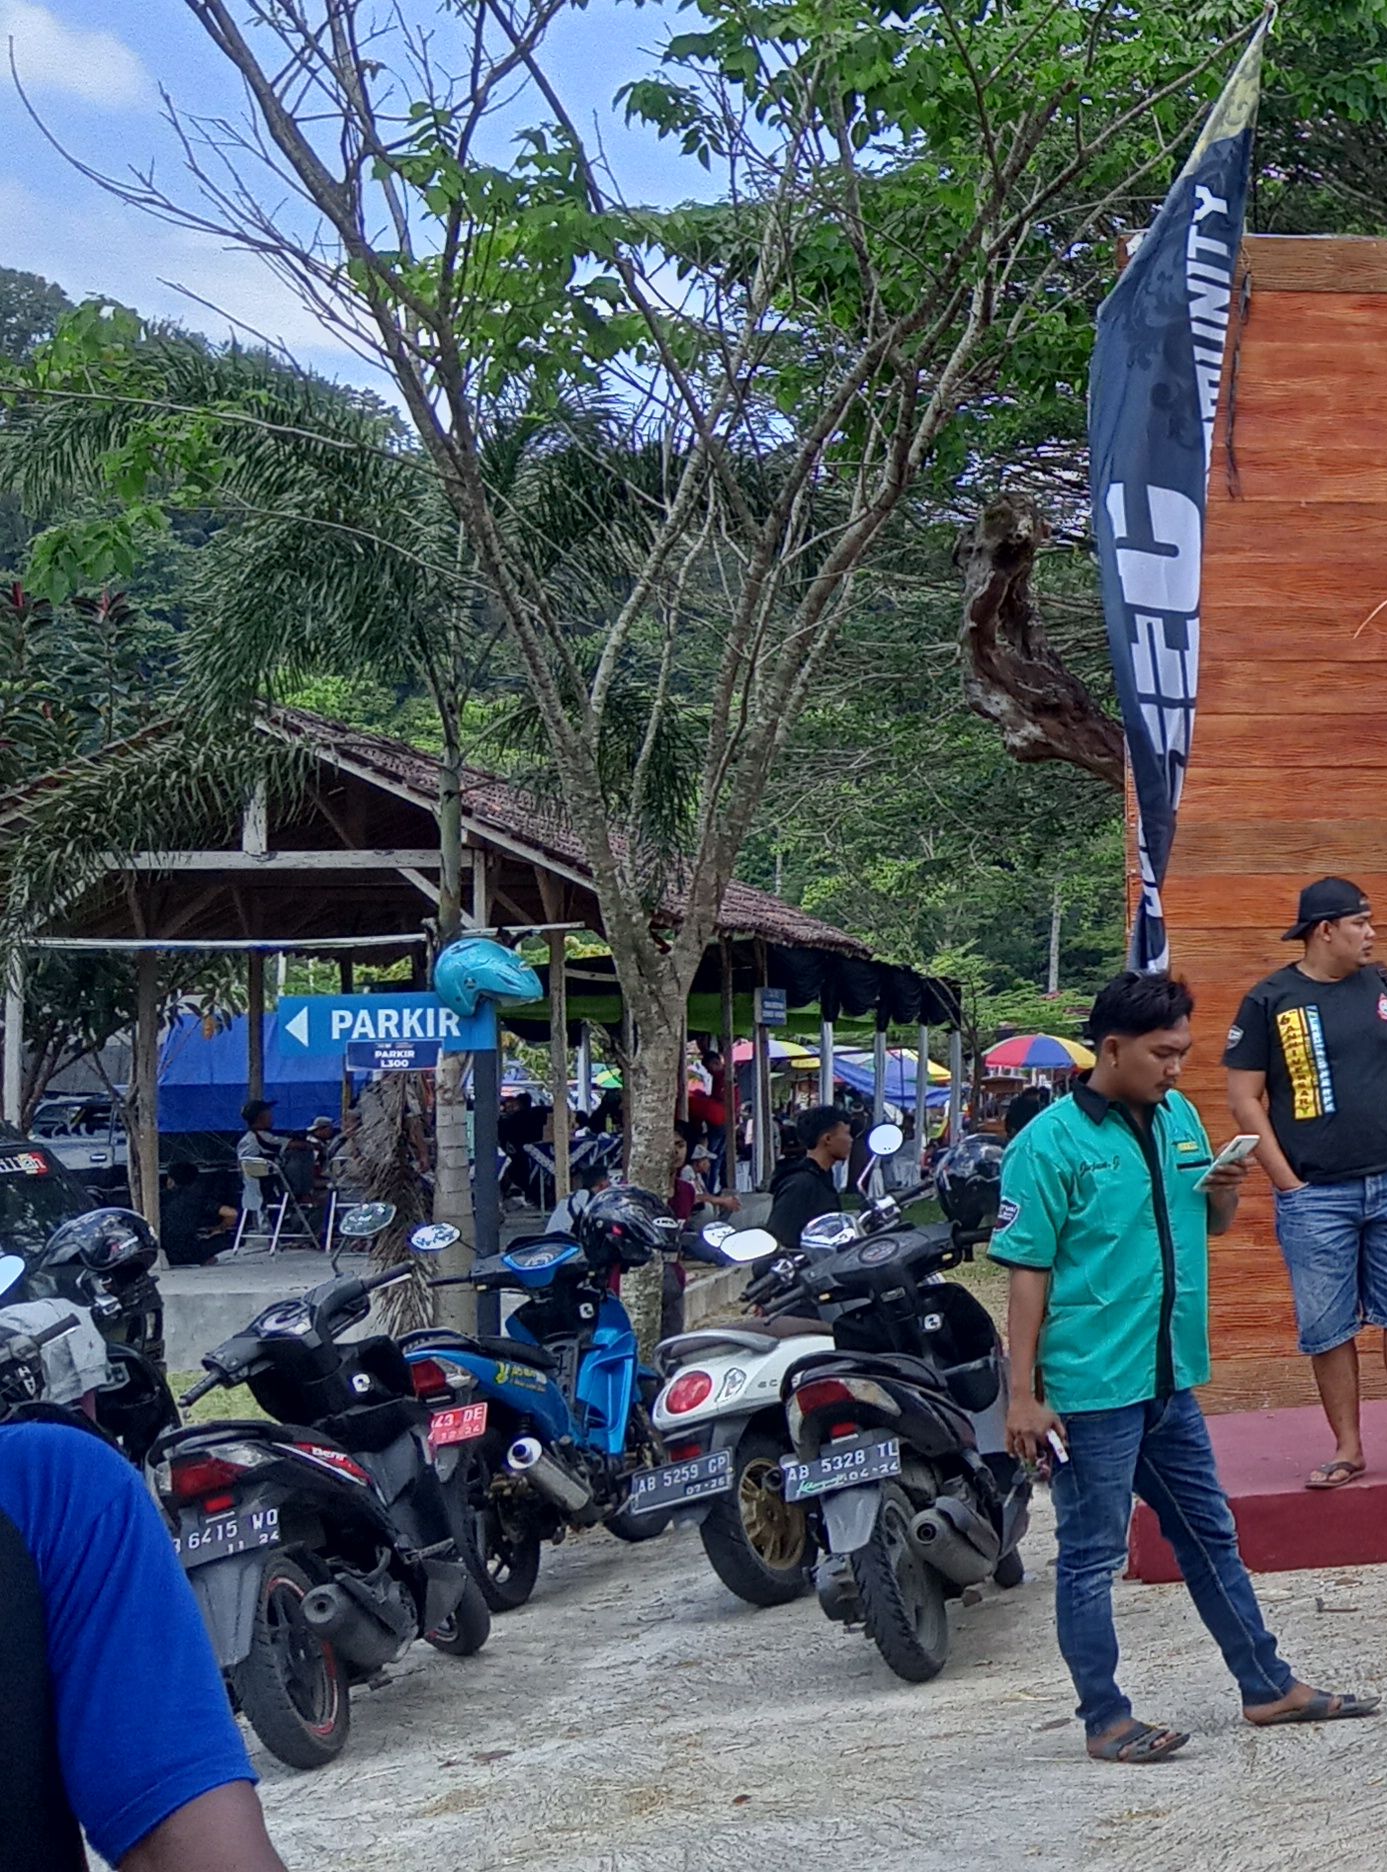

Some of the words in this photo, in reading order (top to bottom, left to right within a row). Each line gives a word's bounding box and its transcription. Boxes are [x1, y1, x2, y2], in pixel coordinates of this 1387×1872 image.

[331, 1007, 462, 1040] PARKIR
[374, 1050, 416, 1059] PARKIR
[463, 1406, 483, 1423] DE
[638, 1475, 657, 1494] AB
[662, 1463, 699, 1487] 5259
[787, 1464, 810, 1482] AB
[820, 1449, 866, 1473] 5328
[188, 1520, 239, 1550] 6415
